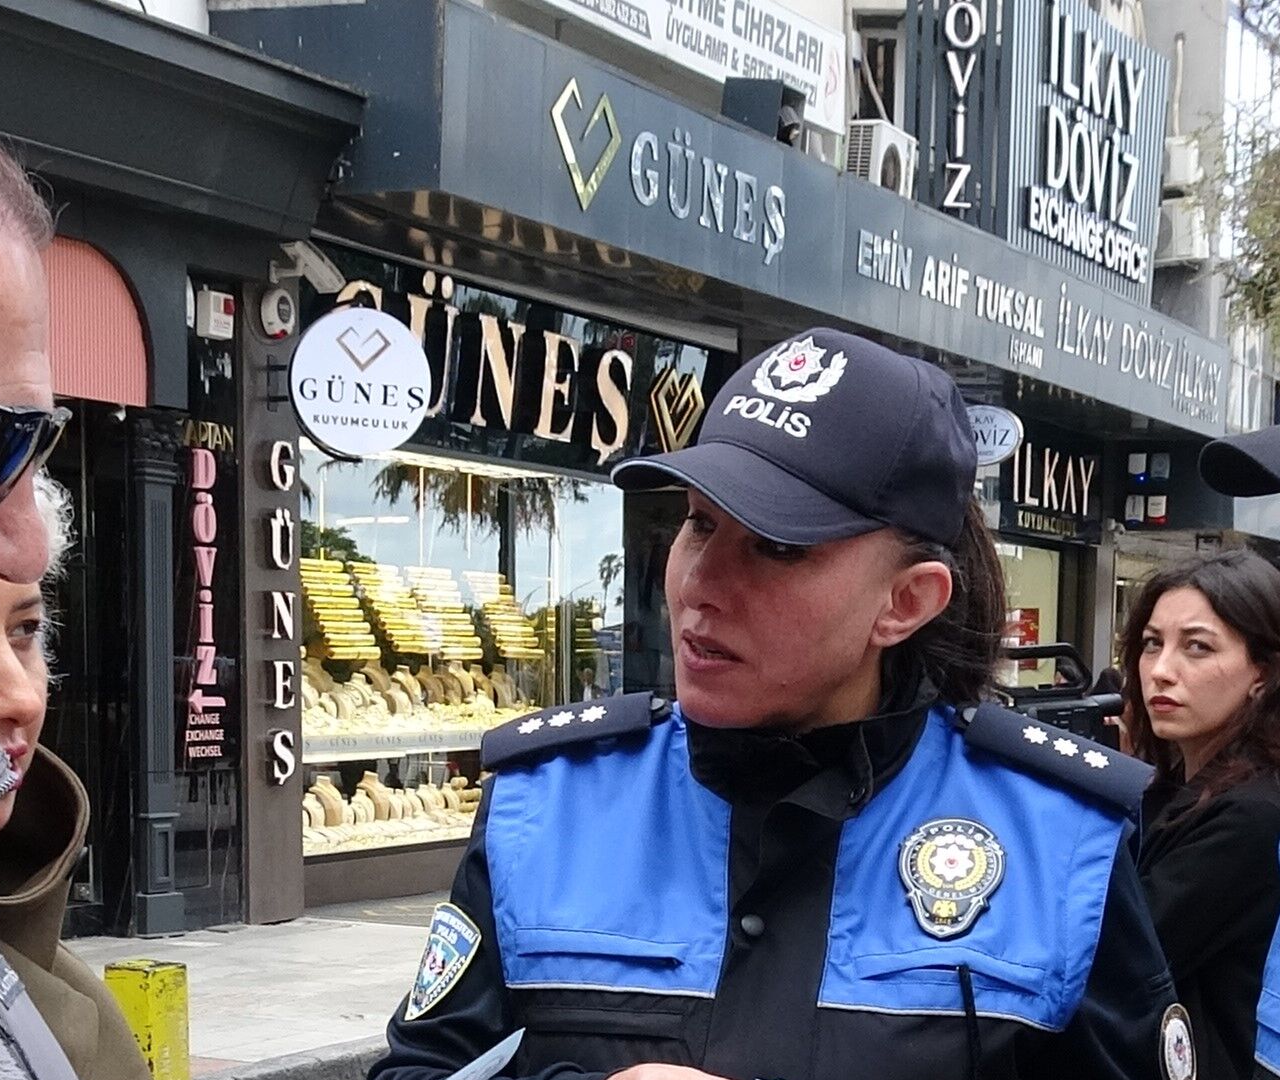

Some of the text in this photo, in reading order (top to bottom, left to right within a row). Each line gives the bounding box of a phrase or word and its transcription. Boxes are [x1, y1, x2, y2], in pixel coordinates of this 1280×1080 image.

[666, 12, 728, 66] UYGULAMA
[731, 47, 739, 72] &
[631, 127, 786, 265] GÜNEŞ
[1047, 104, 1139, 231] DÖVİZ
[1030, 186, 1148, 283] EXCHANGE OFFICE
[858, 229, 1045, 338] EMİN ARİF TUKSAL
[1056, 282, 1114, 366] İLKAY
[1120, 321, 1175, 390] DÖVİZ
[299, 375, 425, 413] GÜNEŞ
[313, 413, 409, 431] KUYUMCULUK
[723, 395, 811, 438] POLİS
[182, 419, 234, 451] APTAN
[191, 449, 218, 685] DÖVİZ
[270, 440, 296, 786] GÜNEŞ
[186, 729, 224, 741] EXCHANGE
[189, 712, 221, 725] CHANGE
[188, 745, 222, 757] WECHSEL
